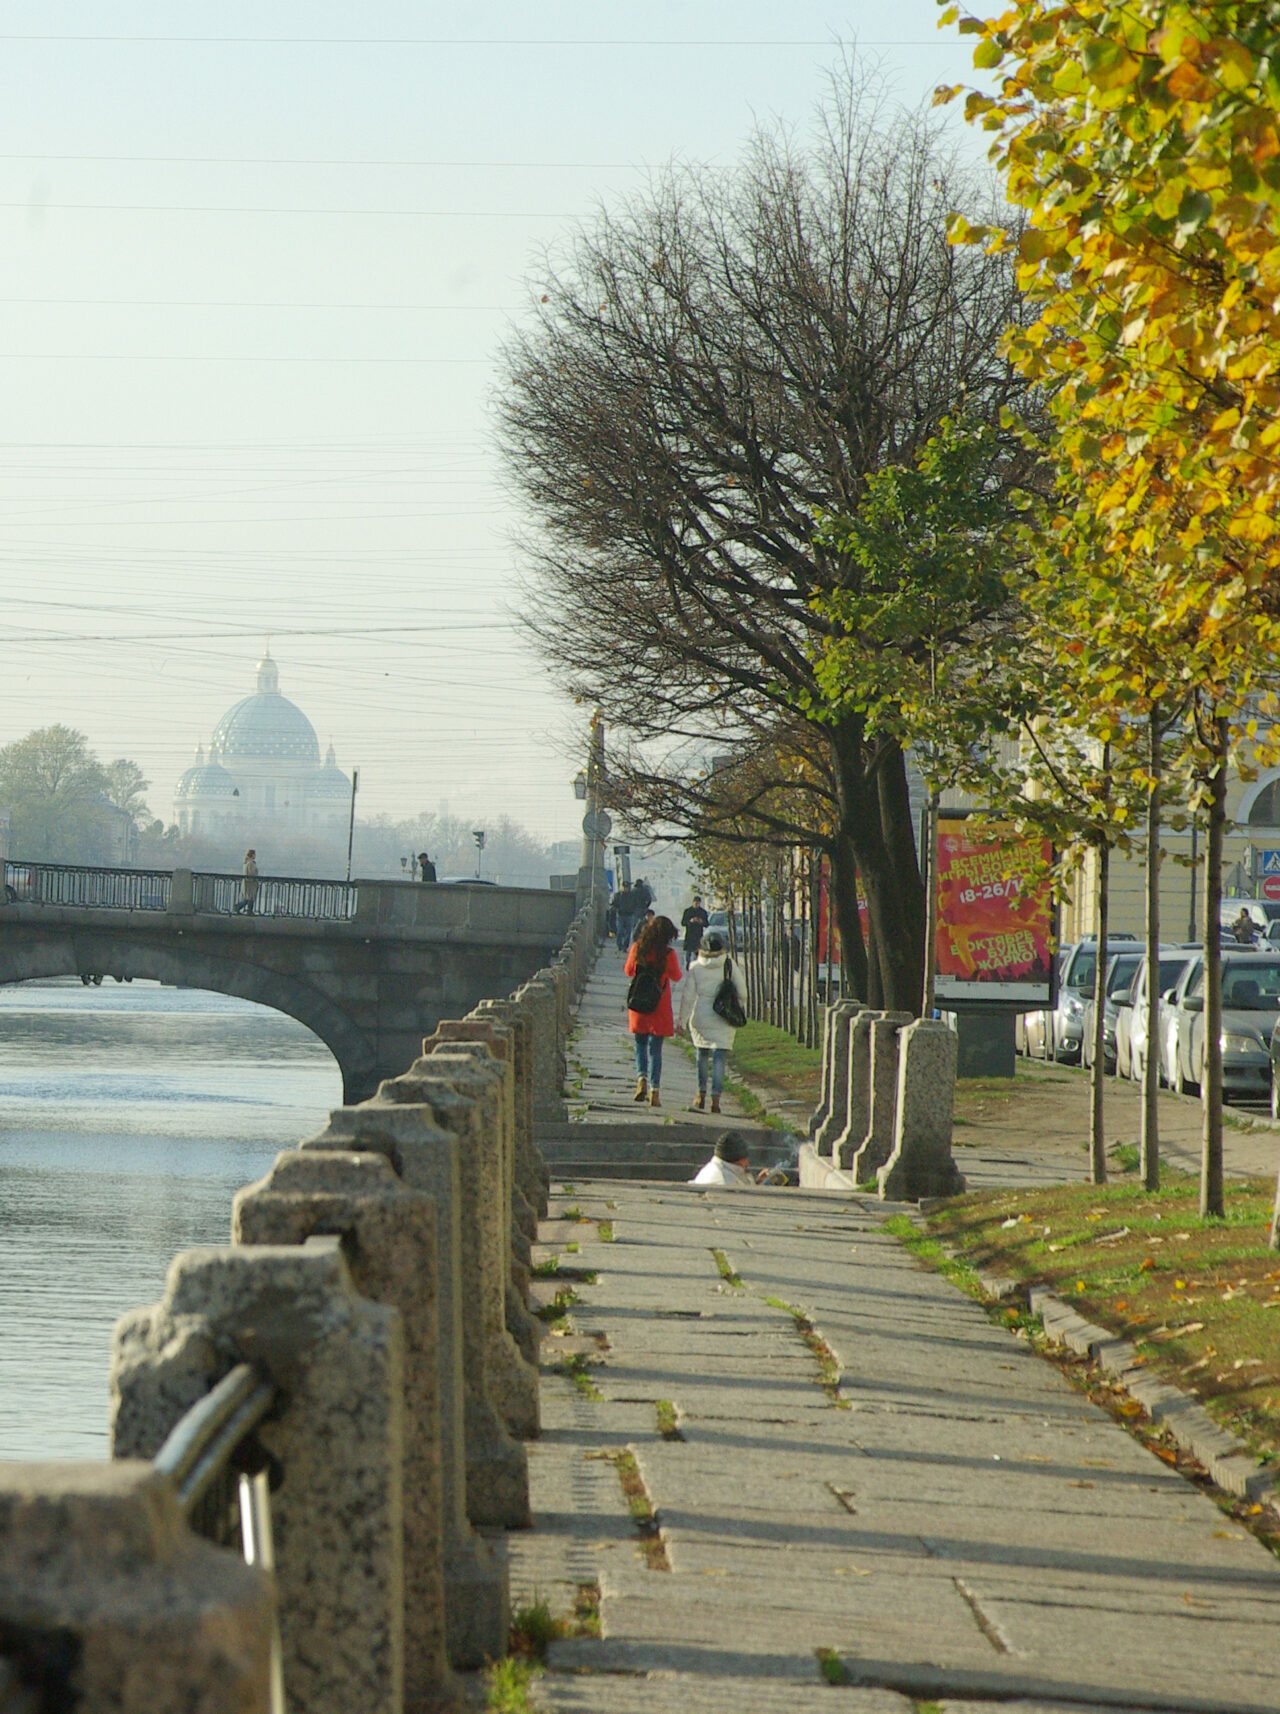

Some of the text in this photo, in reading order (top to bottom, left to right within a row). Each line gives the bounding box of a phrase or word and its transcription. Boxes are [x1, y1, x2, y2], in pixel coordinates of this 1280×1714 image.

[950, 845, 1041, 870] ВСЕМИЫЕ
[937, 866, 979, 882] ИГРЫ
[967, 930, 1035, 952] ОКТЯБРЕ
[987, 941, 1034, 958] БУДЕТ
[977, 950, 1038, 970] ЖАРКО!
